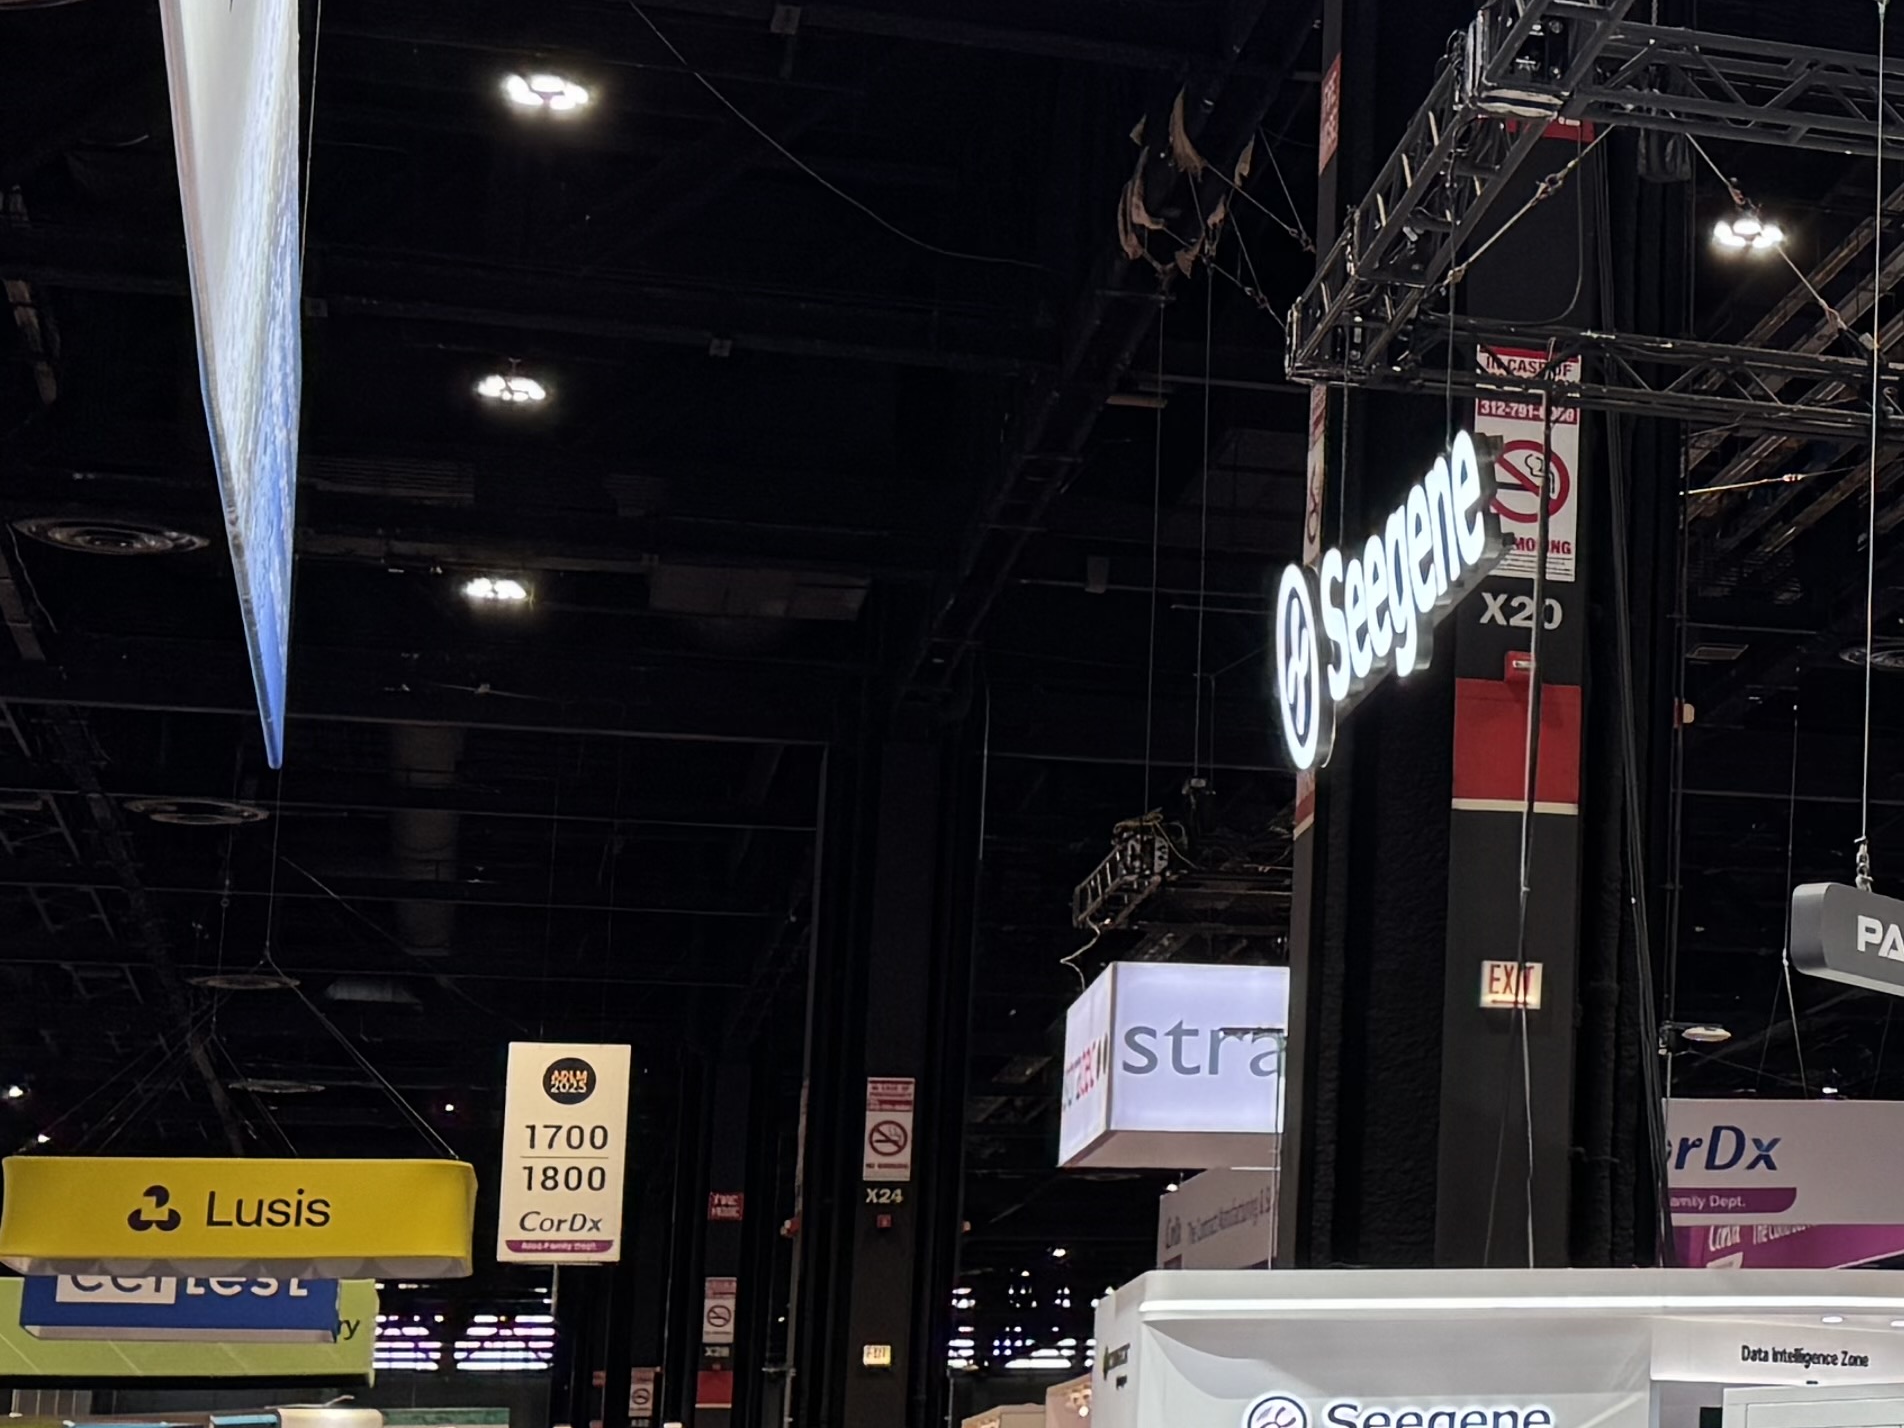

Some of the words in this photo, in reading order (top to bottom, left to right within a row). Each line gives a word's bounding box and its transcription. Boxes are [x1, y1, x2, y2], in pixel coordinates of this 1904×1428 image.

[1320, 430, 1484, 701] Seegene
[1480, 592, 1563, 629] X20
[1122, 1019, 1283, 1077] stra
[550, 1081, 587, 1093] 2025
[525, 1124, 608, 1150] 1700
[522, 1166, 606, 1191] 1800
[206, 1188, 331, 1228] Lusis
[866, 1189, 903, 1203] X24
[1709, 1194, 1746, 1210] Dept.
[520, 1211, 603, 1232] CorDx
[1741, 1344, 1769, 1363] Data
[1772, 1346, 1838, 1369] Intelligence
[1841, 1351, 1869, 1367] Zone
